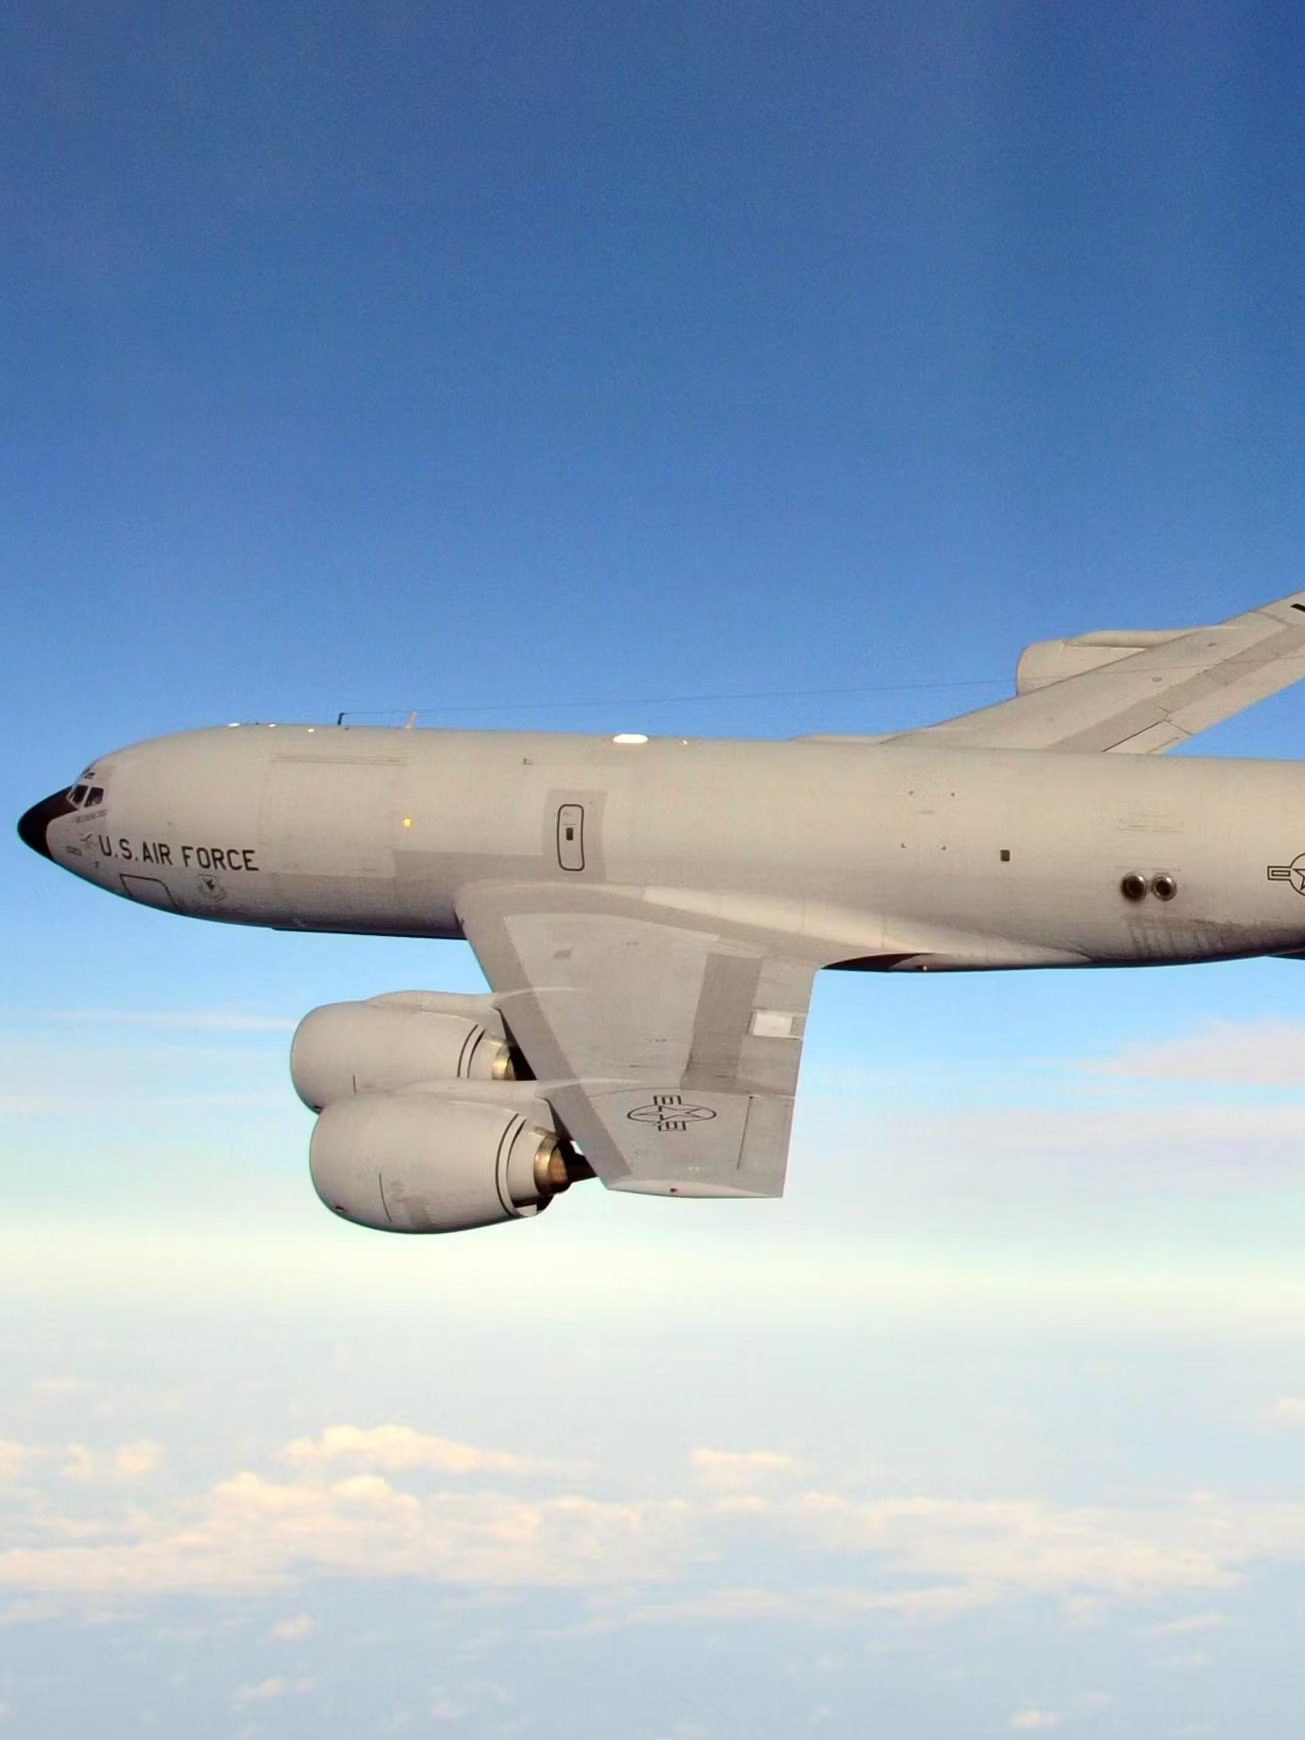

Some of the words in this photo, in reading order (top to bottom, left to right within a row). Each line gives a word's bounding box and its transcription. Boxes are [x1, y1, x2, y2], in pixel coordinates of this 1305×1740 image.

[99, 835, 139, 861] U.S.
[143, 841, 173, 865] AIR
[181, 846, 259, 871] FORCE
